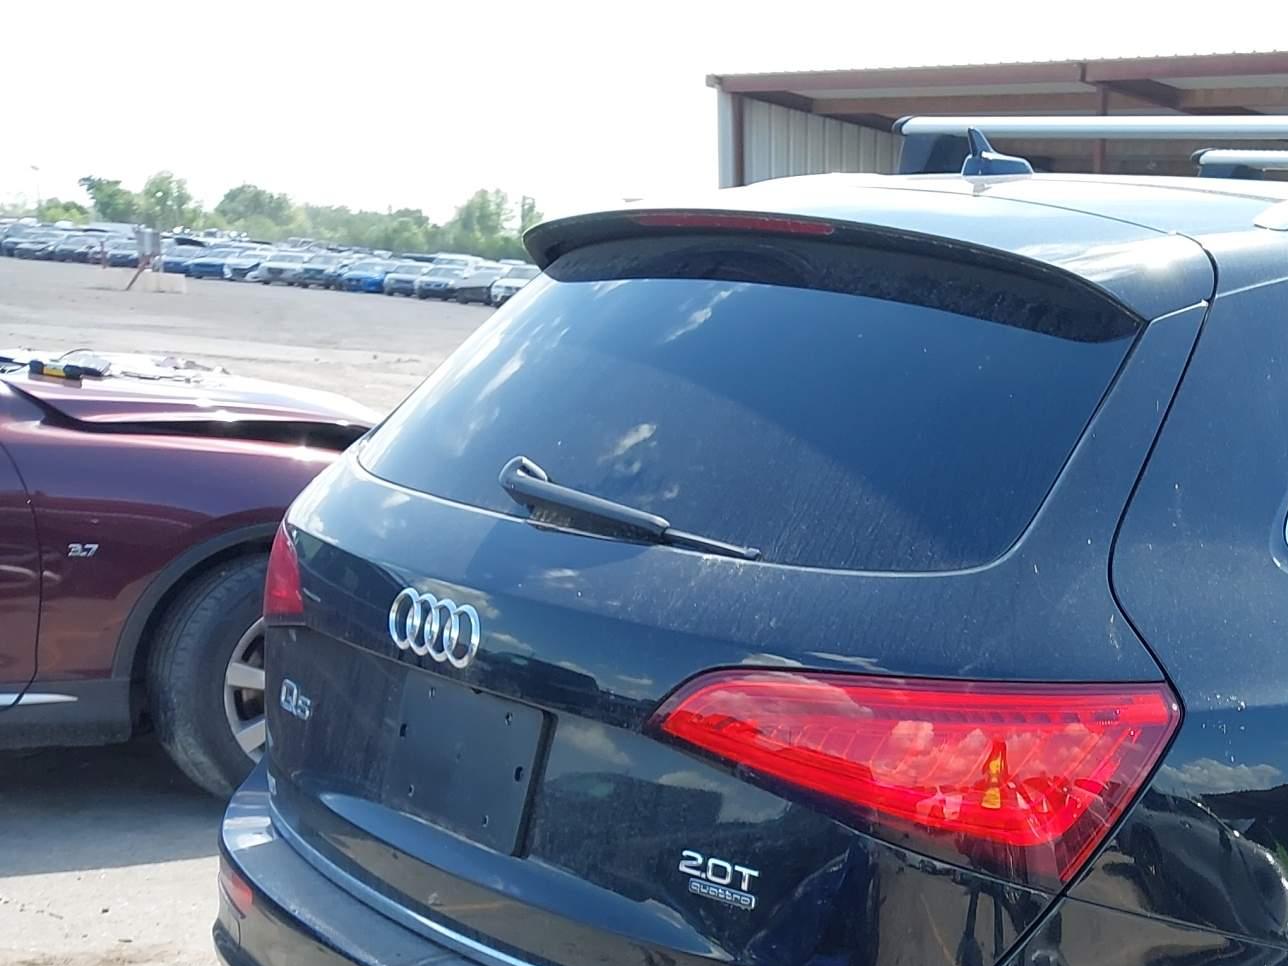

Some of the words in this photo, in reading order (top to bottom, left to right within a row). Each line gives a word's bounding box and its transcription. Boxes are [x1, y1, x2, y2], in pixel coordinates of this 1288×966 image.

[279, 678, 312, 721] Q5
[678, 849, 760, 892] 2.0T
[689, 879, 754, 907] quattro
